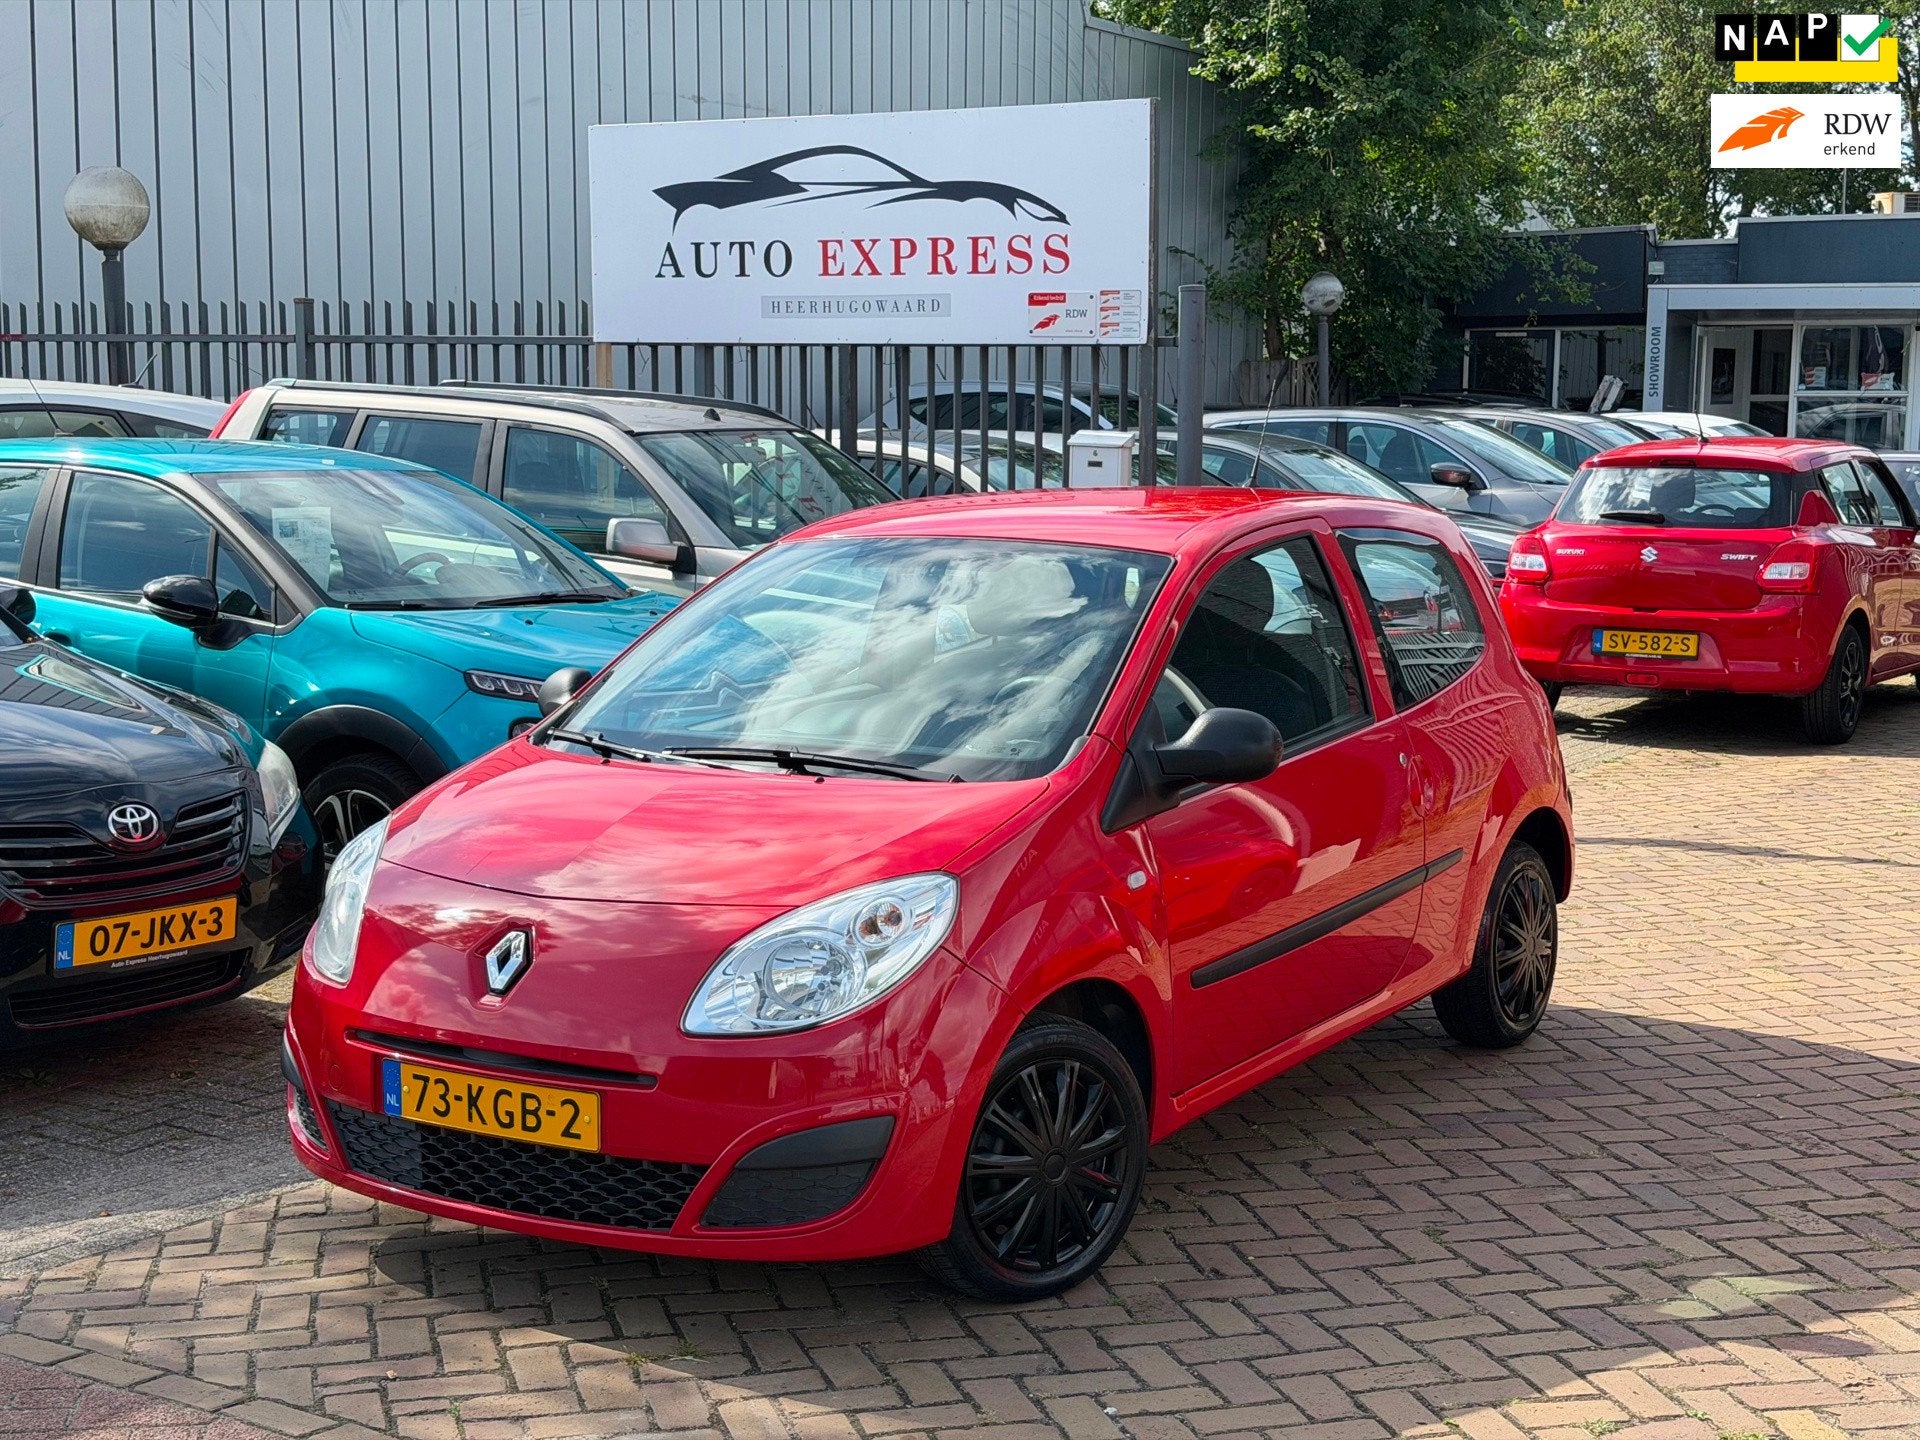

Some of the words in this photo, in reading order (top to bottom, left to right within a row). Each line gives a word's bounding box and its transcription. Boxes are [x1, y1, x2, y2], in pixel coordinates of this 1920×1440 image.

[654, 239, 793, 279] AUTO
[817, 233, 1072, 277] EXPRESS
[771, 298, 941, 315] HEERHUGOWAARD
[1065, 308, 1088, 319] RDW
[1648, 326, 1662, 398] SHOWROOM
[1555, 548, 1586, 557] SUZUKI
[1720, 552, 1758, 561] SWIFT
[1608, 633, 1691, 653] SV-582-S
[89, 906, 224, 957] 07-JKX-3
[57, 950, 71, 962] NL
[386, 1092, 400, 1107] NL
[411, 1073, 582, 1140] 73-KGB-2
